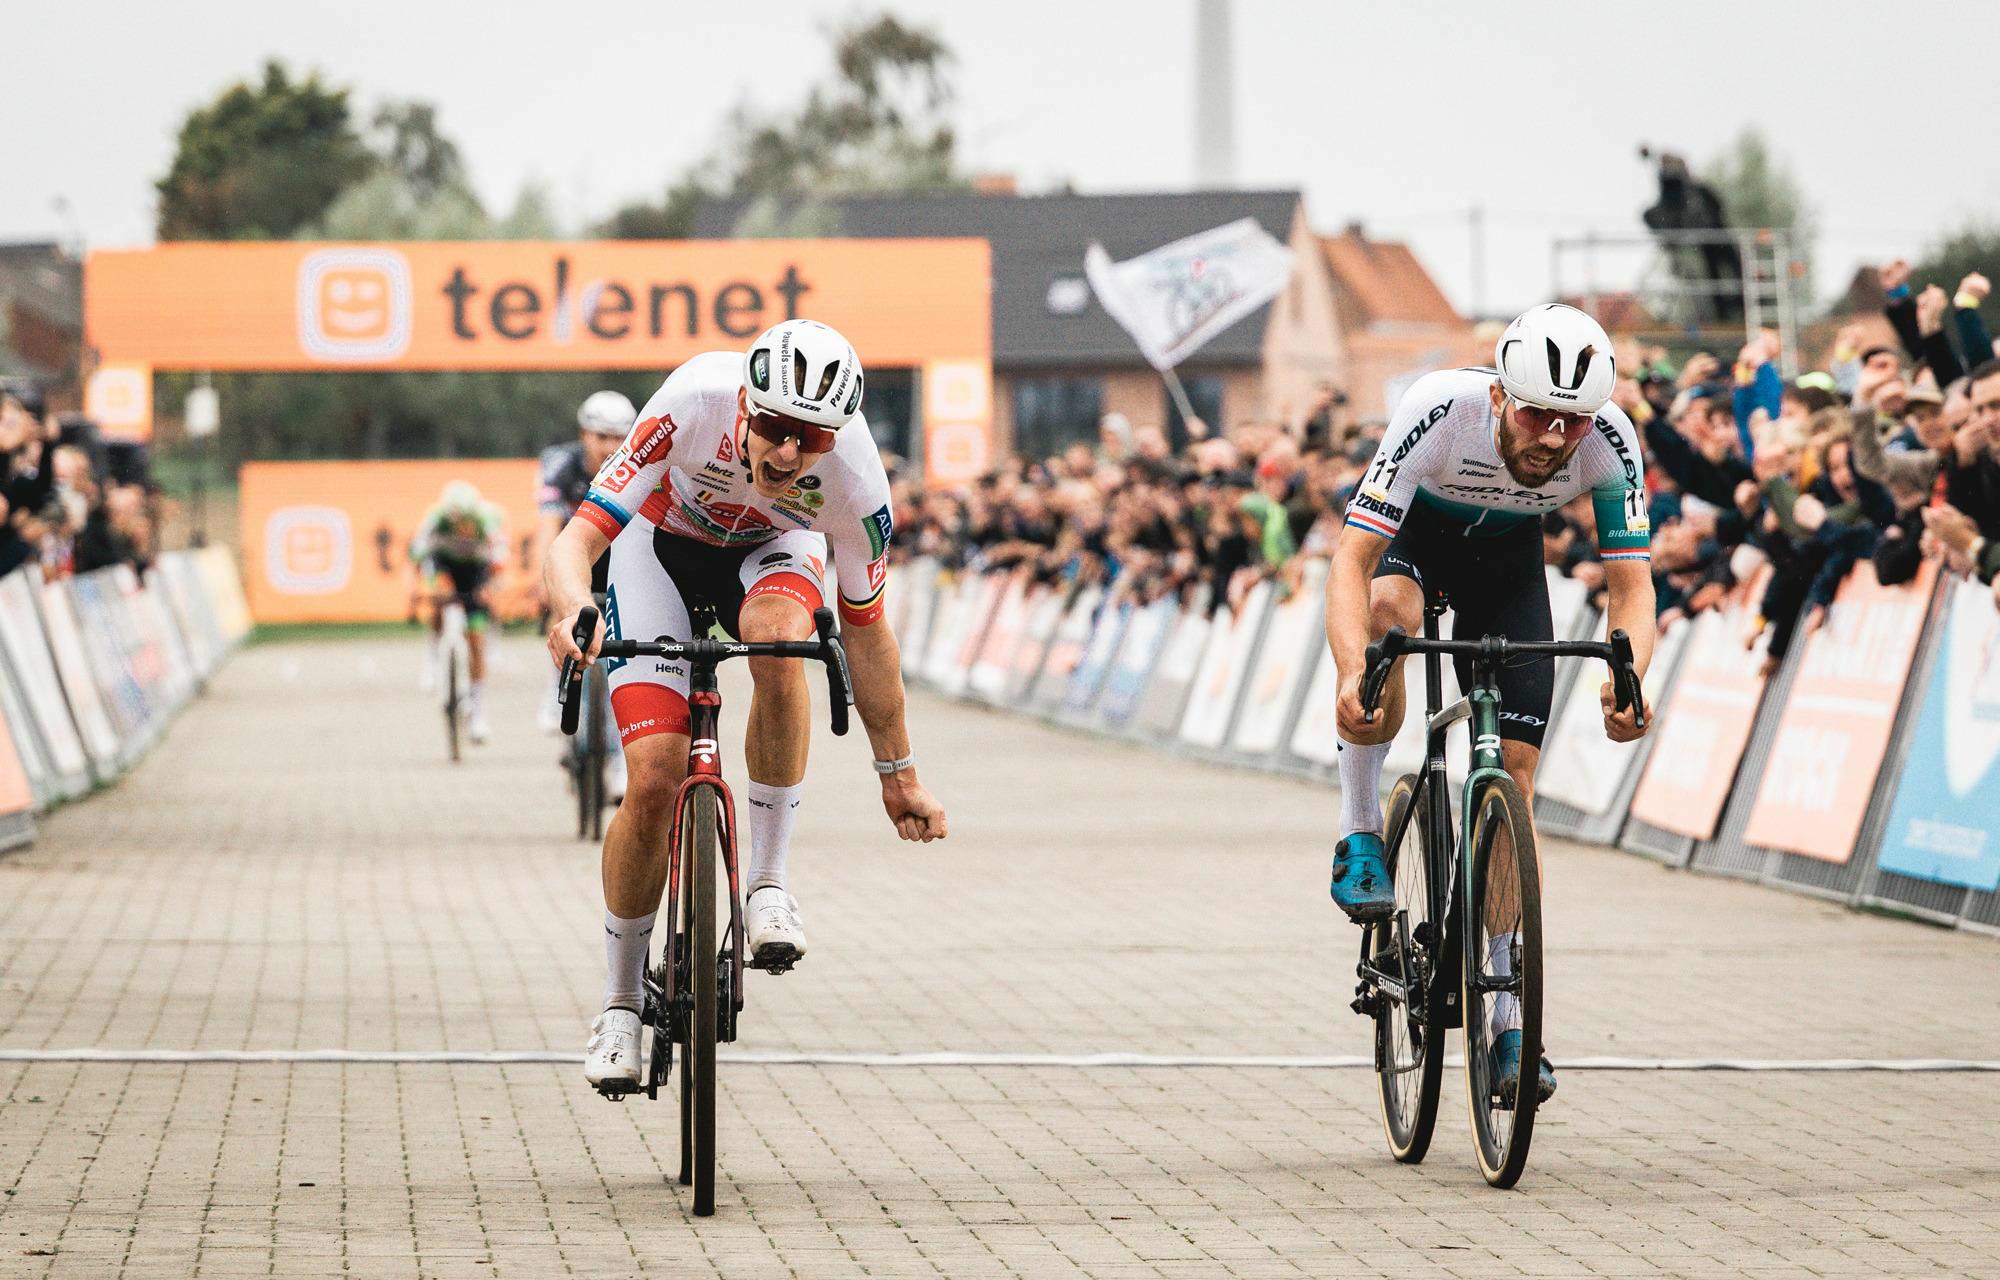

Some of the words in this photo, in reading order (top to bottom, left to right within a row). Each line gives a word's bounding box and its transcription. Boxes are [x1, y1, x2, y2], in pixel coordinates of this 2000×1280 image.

[442, 256, 810, 340] telenet
[781, 331, 792, 362] Pauwels
[781, 364, 789, 396] sauzen
[830, 367, 851, 407] Pauwels
[1549, 391, 1578, 400] LAZER
[791, 400, 821, 413] LAZER
[1391, 398, 1454, 465] RIDLEY
[632, 420, 673, 464] Pauwels
[1595, 415, 1637, 489] RIDLEY
[704, 461, 735, 478] Hertz
[1462, 458, 1498, 471] SHIMANO
[1373, 458, 1400, 493] 11
[1552, 474, 1571, 482] WISS
[1355, 493, 1404, 523] 226ERS
[782, 585, 807, 602] bree
[659, 643, 684, 652] Deda
[724, 643, 749, 652] Deda
[655, 663, 685, 677] Hertz
[1498, 711, 1546, 726] DLEY
[621, 727, 630, 738] de
[630, 718, 655, 731] bree
